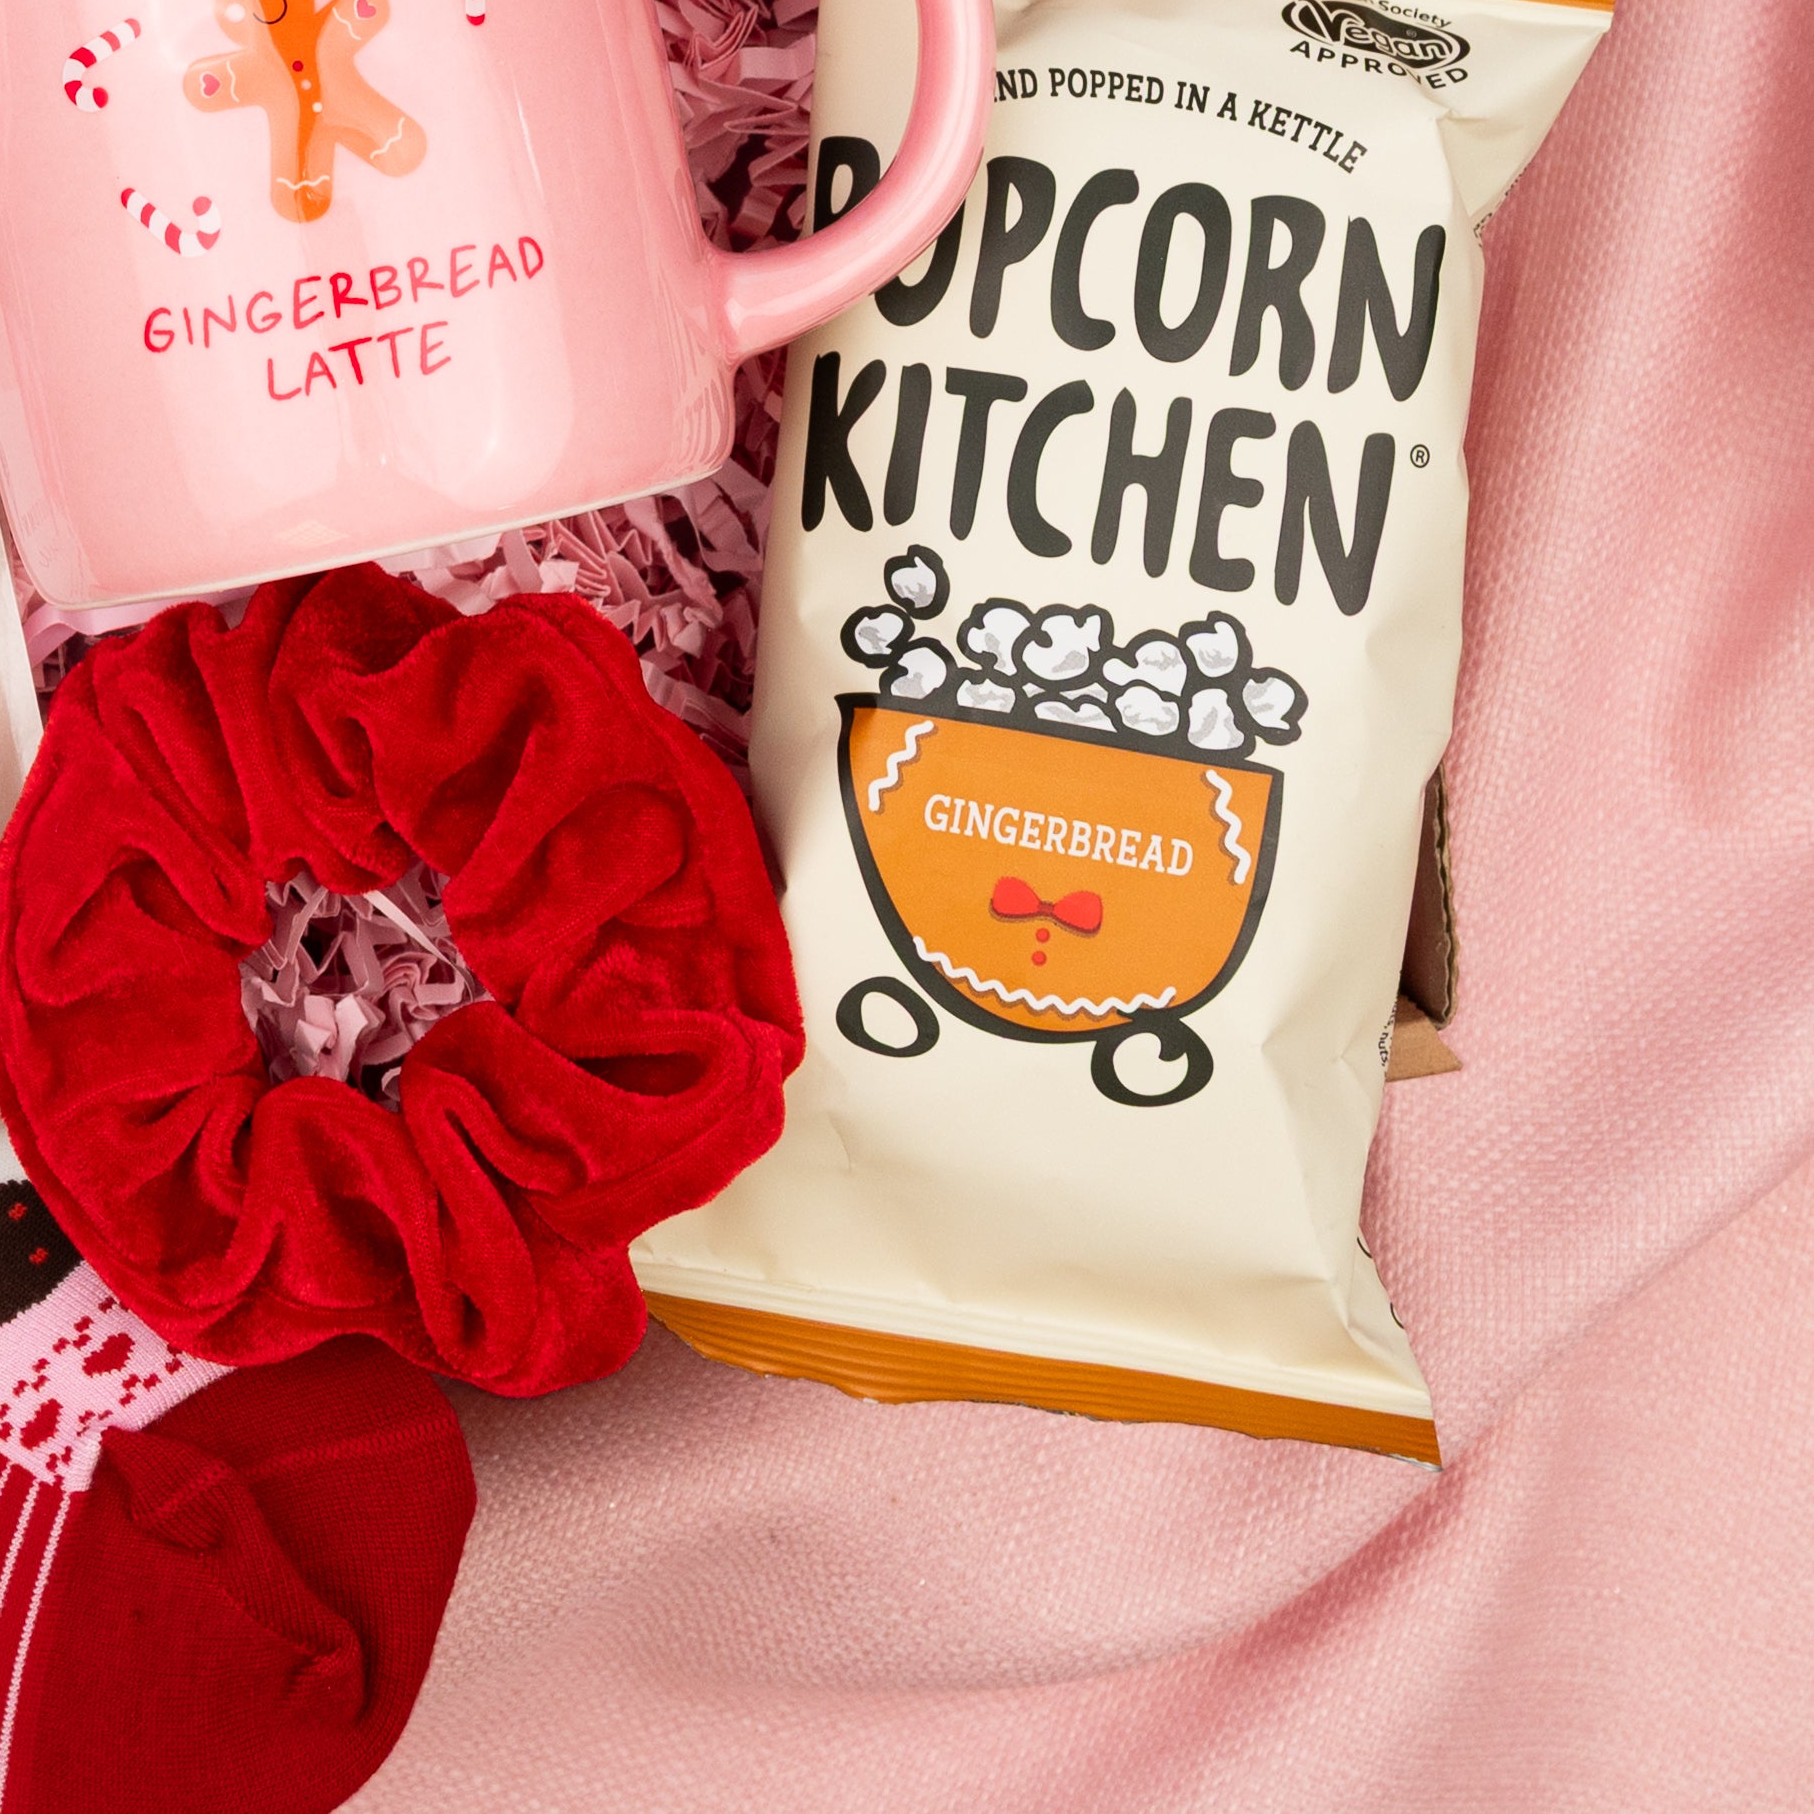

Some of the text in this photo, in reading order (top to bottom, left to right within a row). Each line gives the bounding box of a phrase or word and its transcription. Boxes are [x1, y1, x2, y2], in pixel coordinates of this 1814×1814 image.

[1378, 0, 1452, 28] Society
[994, 67, 1368, 174] ND POPPED IN A KETTLE
[144, 236, 544, 353] GINGERBREAD
[267, 321, 451, 400] LATTE
[924, 793, 1194, 876] GINGERBREAD
